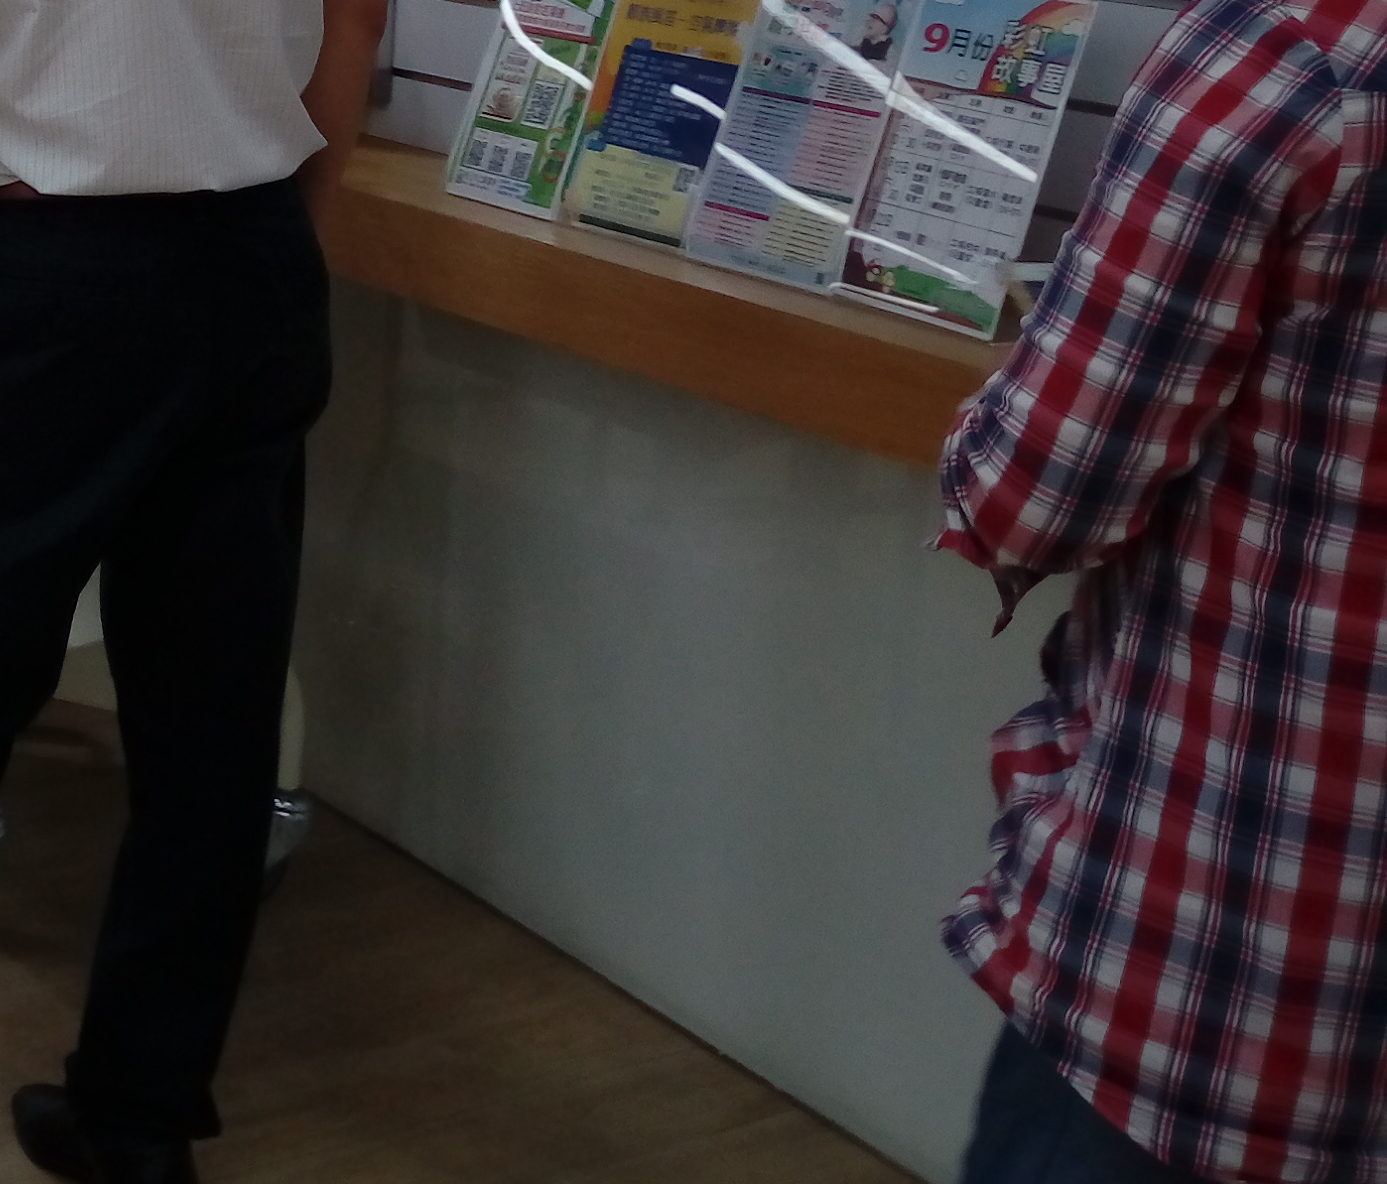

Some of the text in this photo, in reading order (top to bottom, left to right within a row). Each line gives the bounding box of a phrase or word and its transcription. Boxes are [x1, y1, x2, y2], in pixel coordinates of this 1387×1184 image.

[922, 22, 995, 61] 9月份
[1001, 19, 1054, 56] 彩虹
[991, 55, 1068, 95] 故事屋
